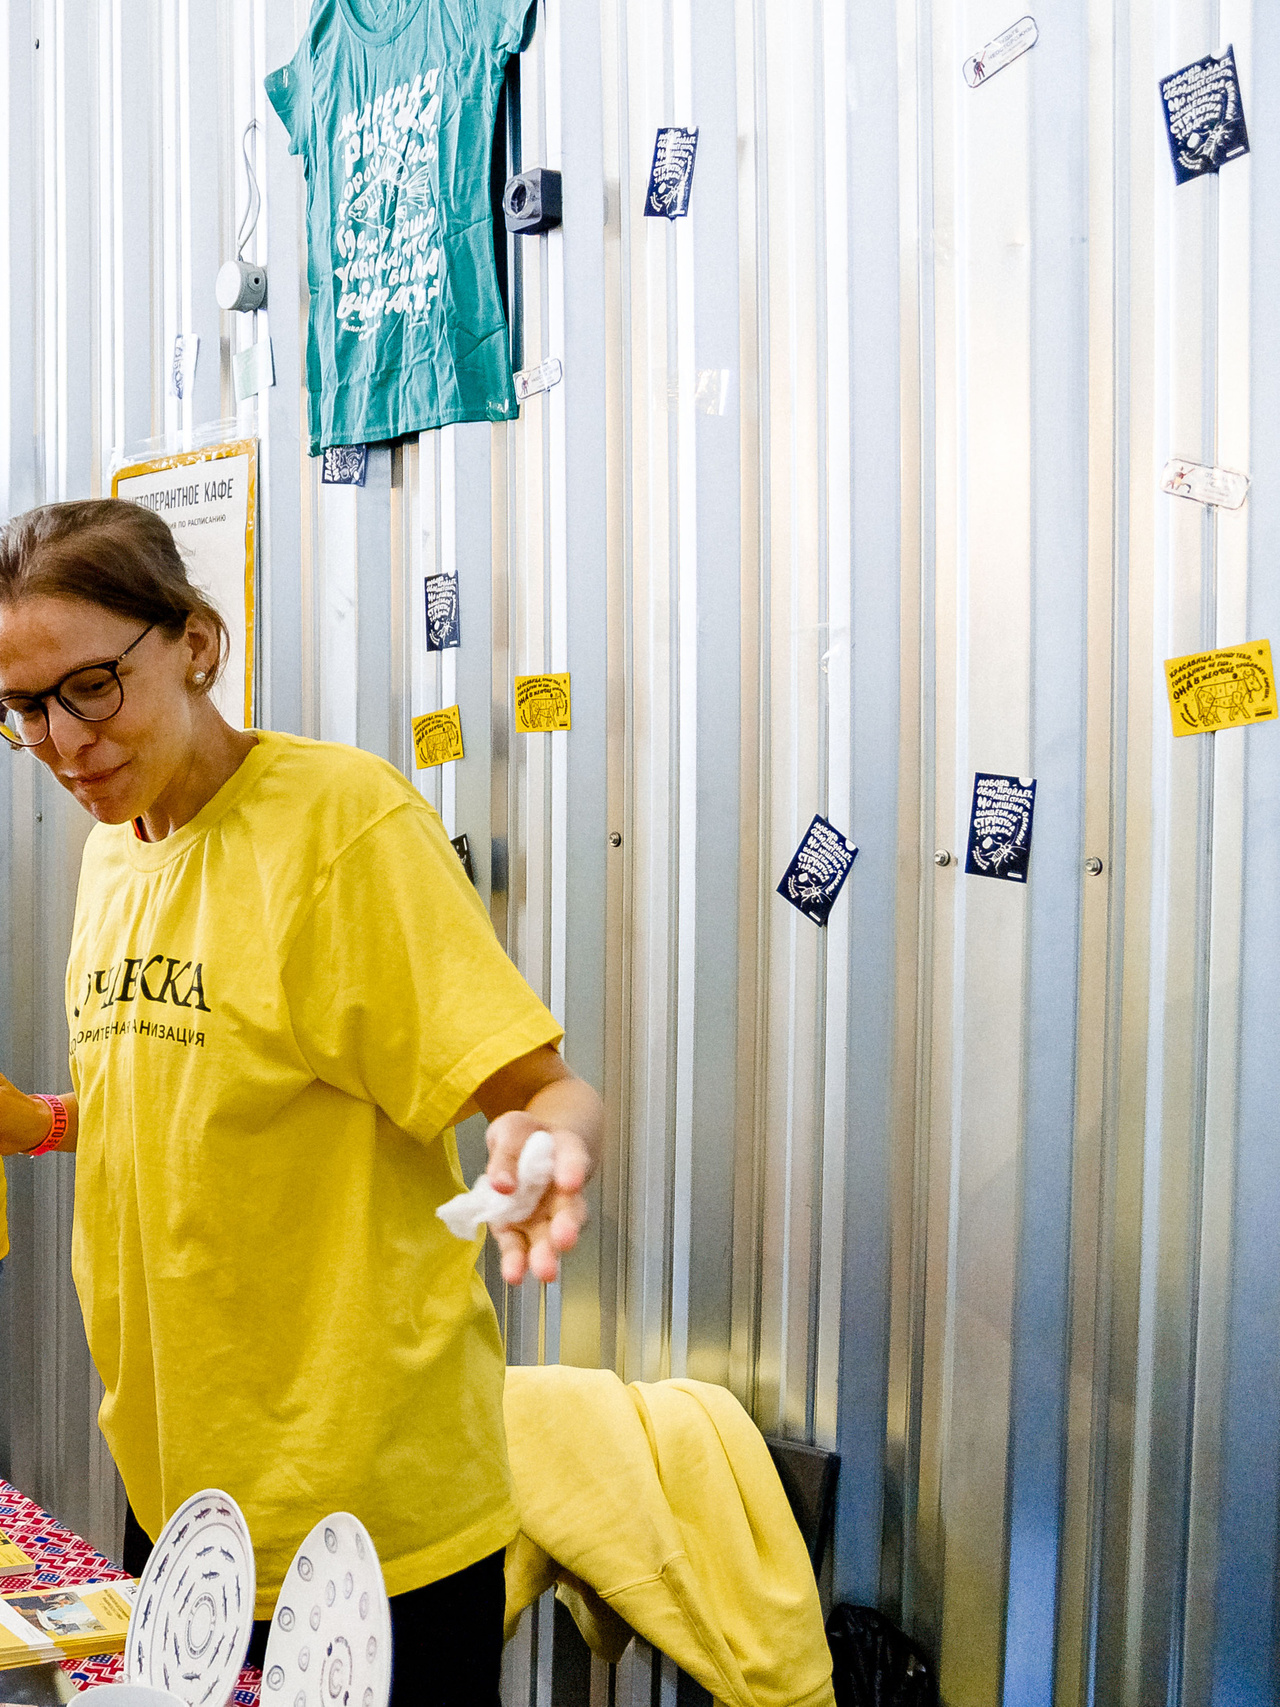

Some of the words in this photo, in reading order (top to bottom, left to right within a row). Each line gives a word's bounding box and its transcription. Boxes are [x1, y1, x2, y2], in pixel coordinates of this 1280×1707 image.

[130, 484, 200, 512] ТОЛЕРАНТНОЕ
[204, 478, 234, 503] КАФЕ
[187, 514, 227, 527] РАСПИСАНИЮ
[1172, 680, 1194, 700] ОНА
